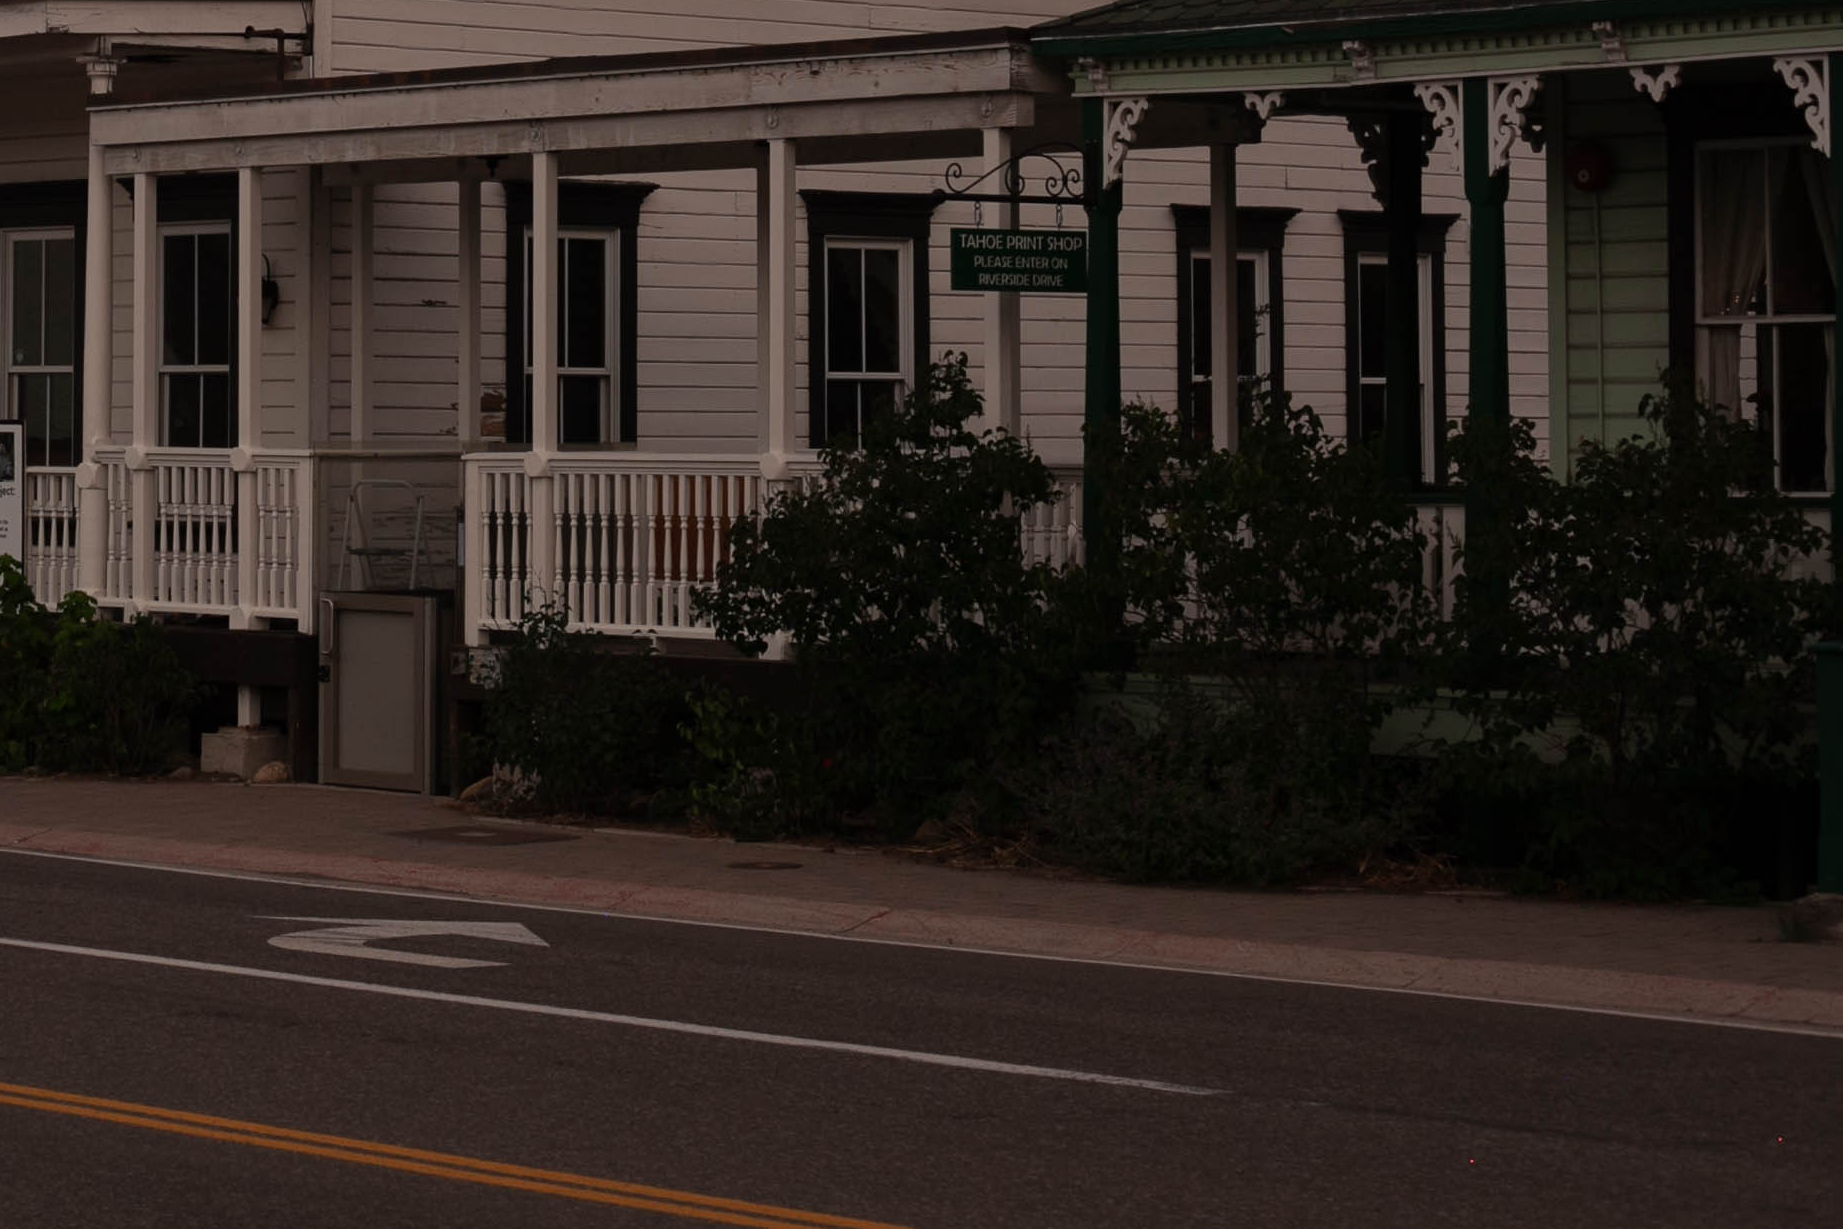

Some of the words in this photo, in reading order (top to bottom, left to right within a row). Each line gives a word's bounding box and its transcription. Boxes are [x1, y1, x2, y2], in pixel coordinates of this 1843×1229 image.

[959, 233, 1004, 249] TAHOE
[1006, 235, 1044, 251] PRINT
[1047, 236, 1083, 252] SHOP
[973, 255, 1013, 268] PLEASE
[1015, 256, 1049, 269] ENTER
[1051, 258, 1068, 270] ON
[978, 273, 1030, 286] RIVERSIDE
[1032, 274, 1064, 287] DRIVE
